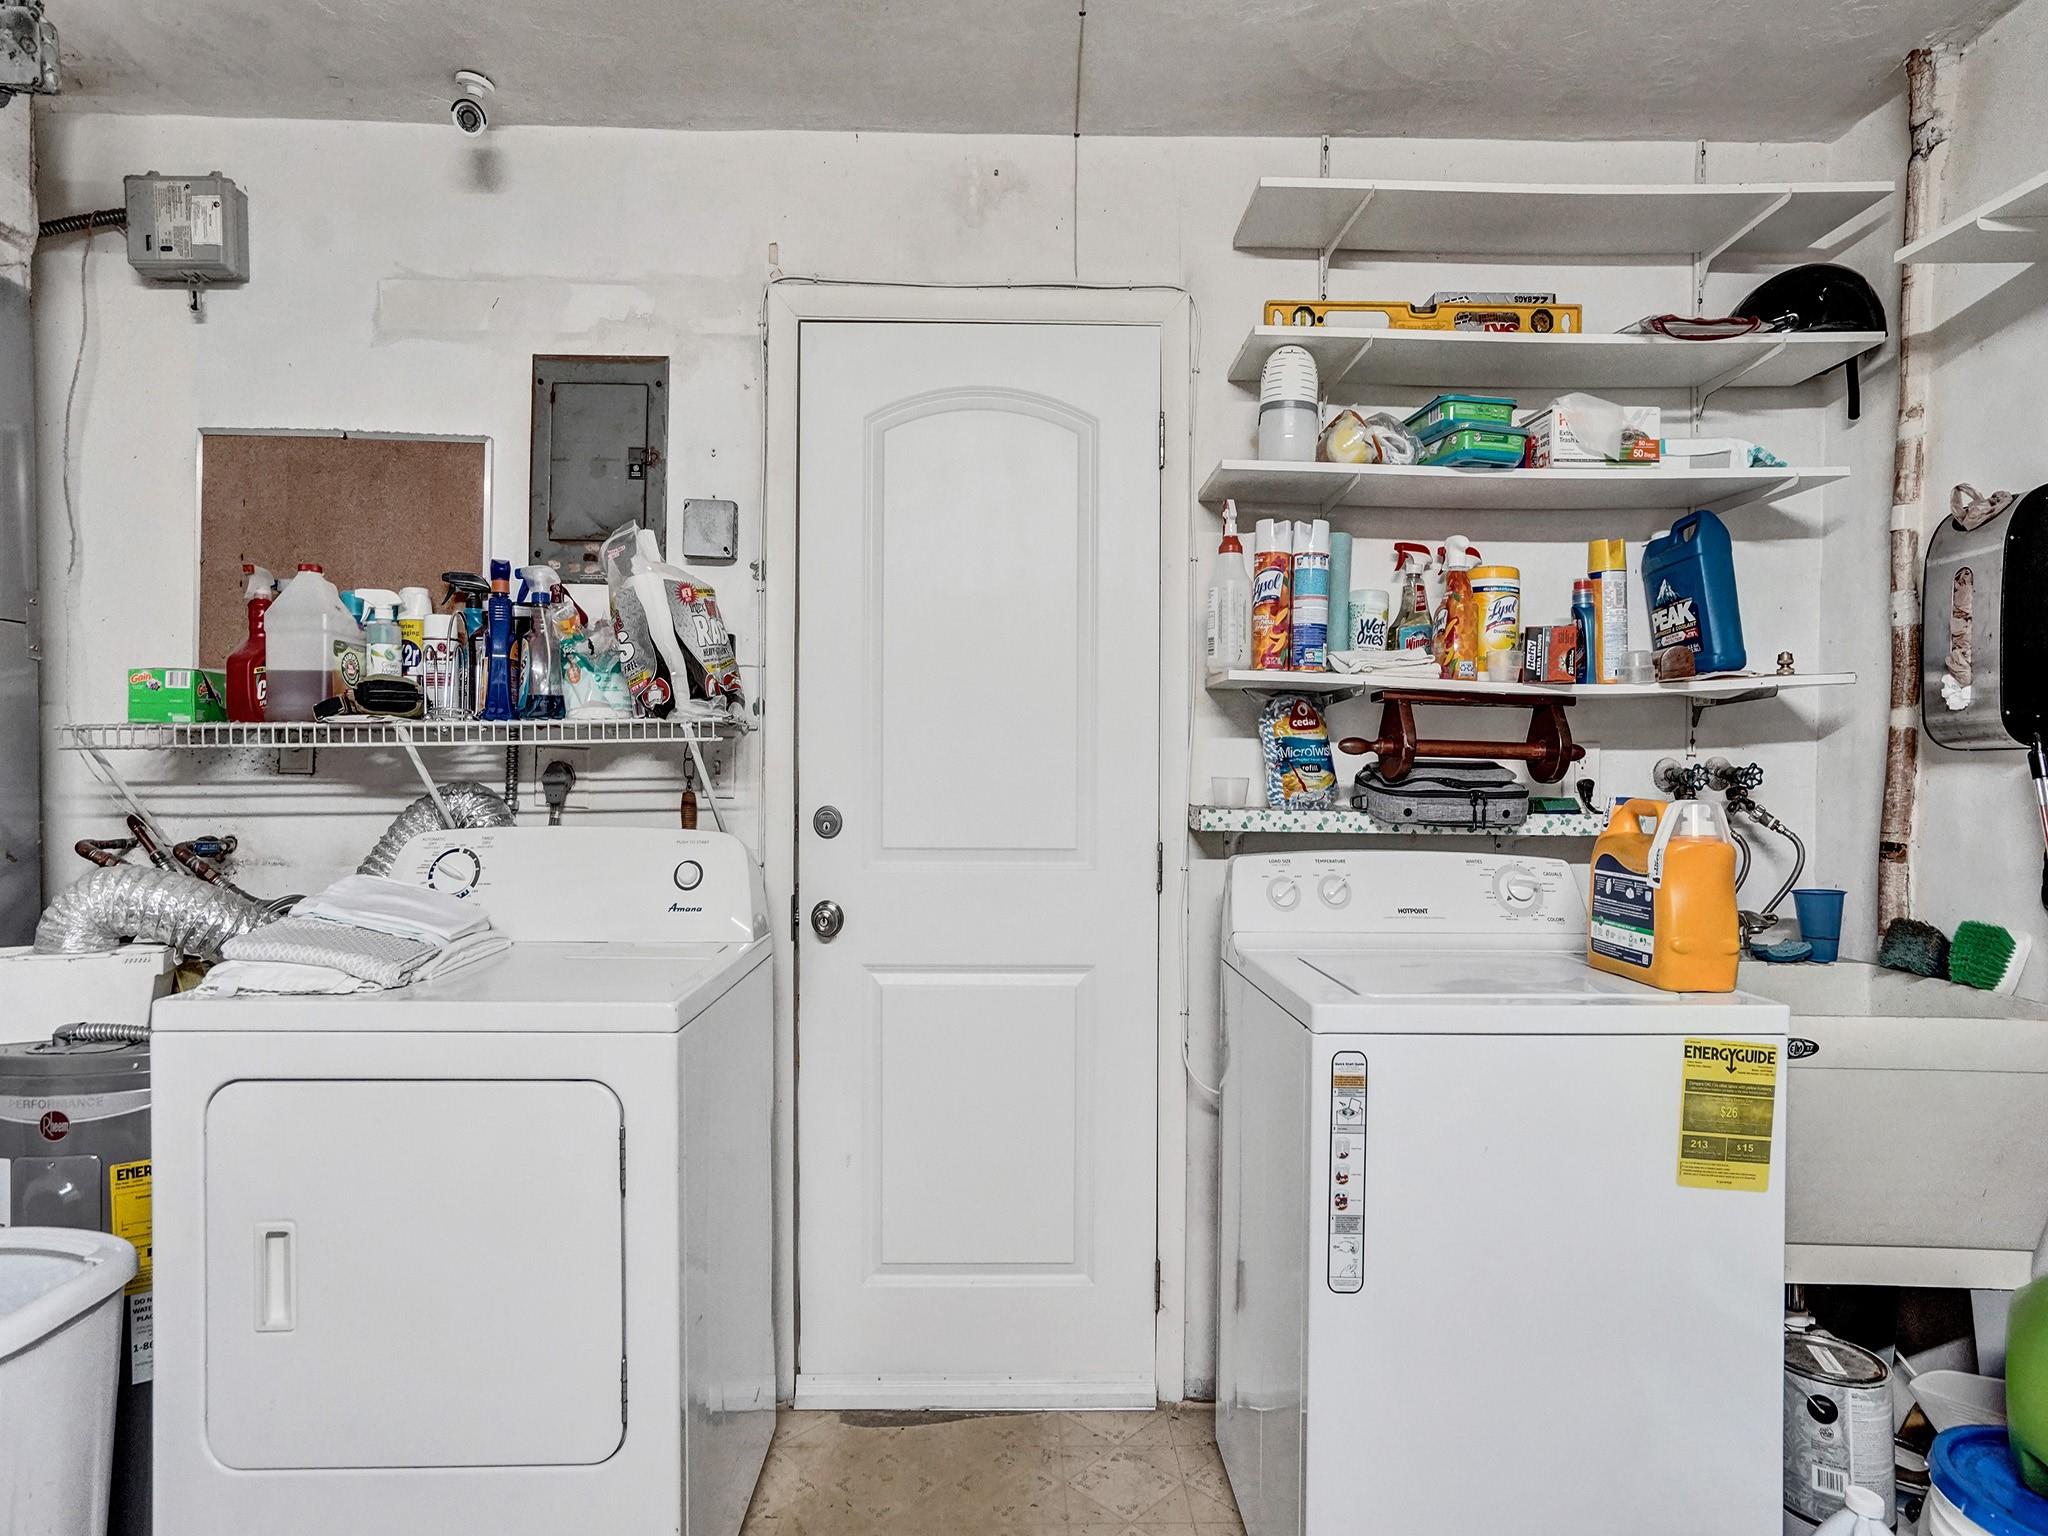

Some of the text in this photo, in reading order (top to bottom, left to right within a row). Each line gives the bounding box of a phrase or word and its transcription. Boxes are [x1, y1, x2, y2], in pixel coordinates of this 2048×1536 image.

[1633, 449, 1657, 458] 50 Bags
[1488, 600, 1517, 621] Lysol
[1651, 600, 1697, 634] PEAK
[1360, 617, 1385, 634] Wet
[1357, 631, 1385, 646] Ones
[1527, 640, 1537, 669] Hefty
[130, 673, 151, 683] Gain
[1292, 718, 1316, 727] cedar
[1302, 764, 1319, 772] refill
[668, 903, 703, 913] Amana
[1684, 1045, 1777, 1066] ENERGYGUIDE
[1720, 1106, 1738, 1119] $26
[42, 1112, 69, 1137] Rheem
[1690, 1139, 1709, 1149] 213
[134, 1297, 146, 1306] DO
